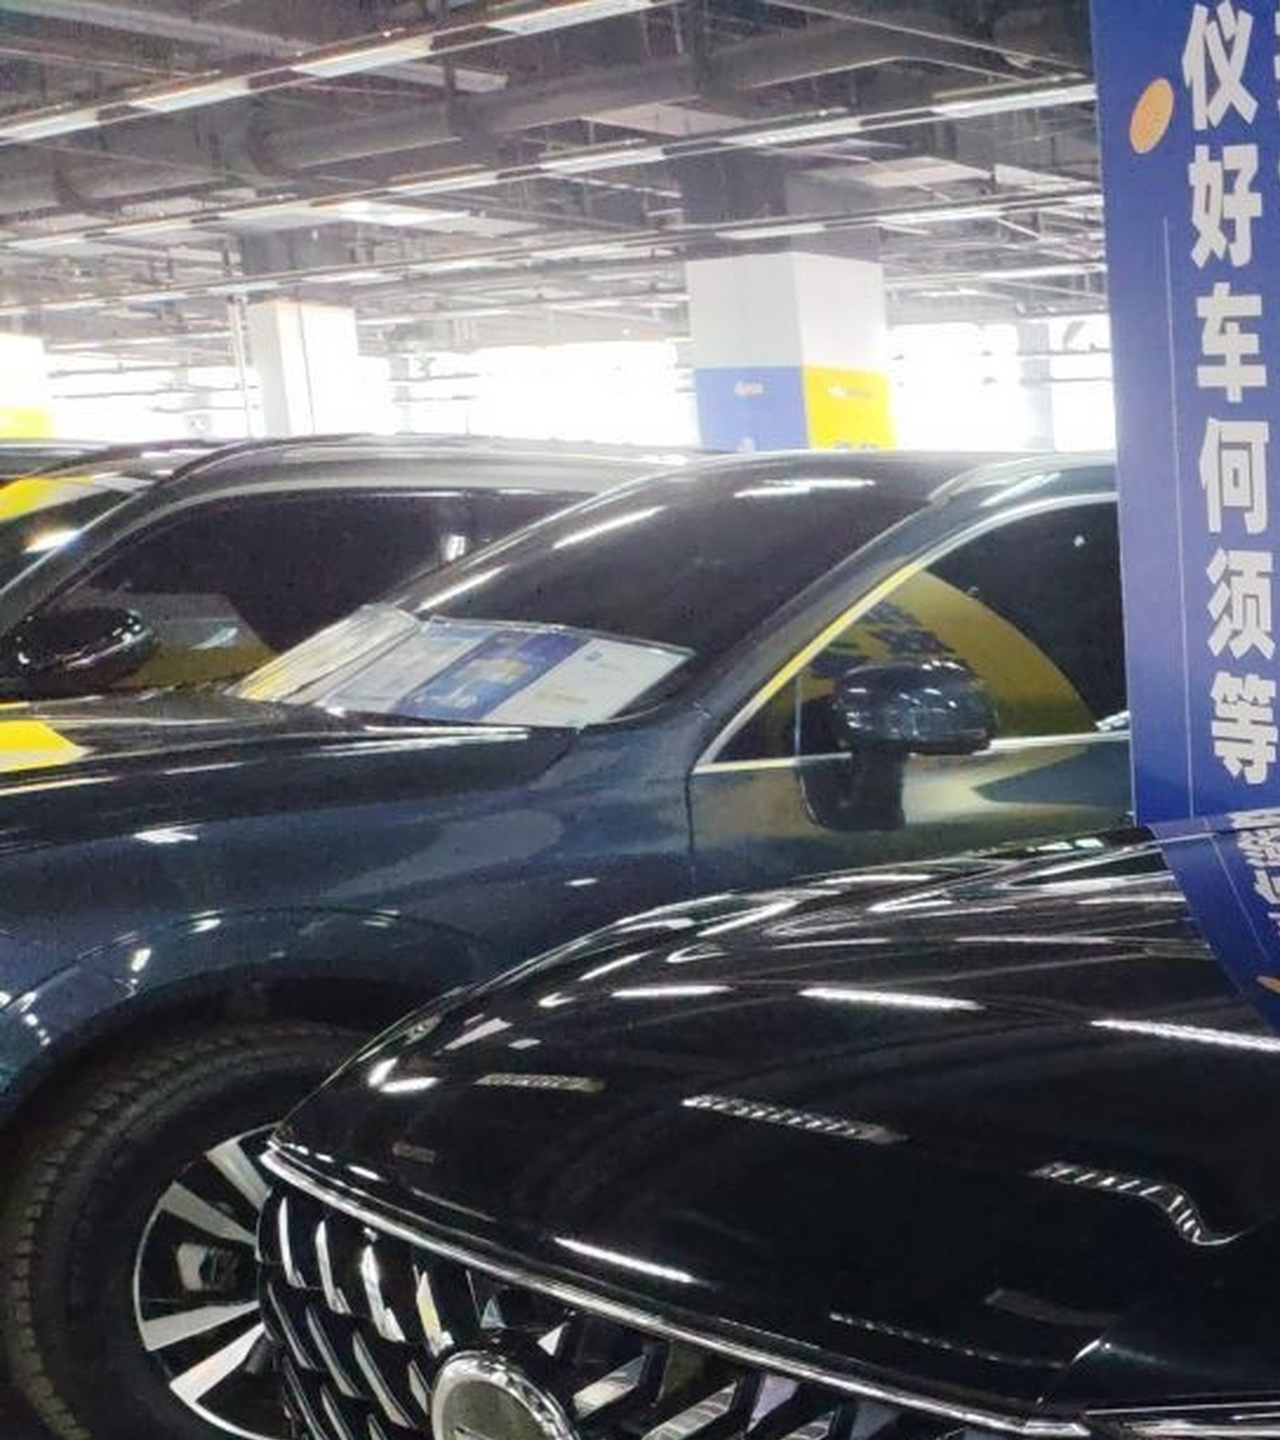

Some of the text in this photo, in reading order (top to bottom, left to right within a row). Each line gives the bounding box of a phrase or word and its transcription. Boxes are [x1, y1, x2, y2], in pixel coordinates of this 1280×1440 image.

[1181, 2, 1279, 786] 仪好车何须等
